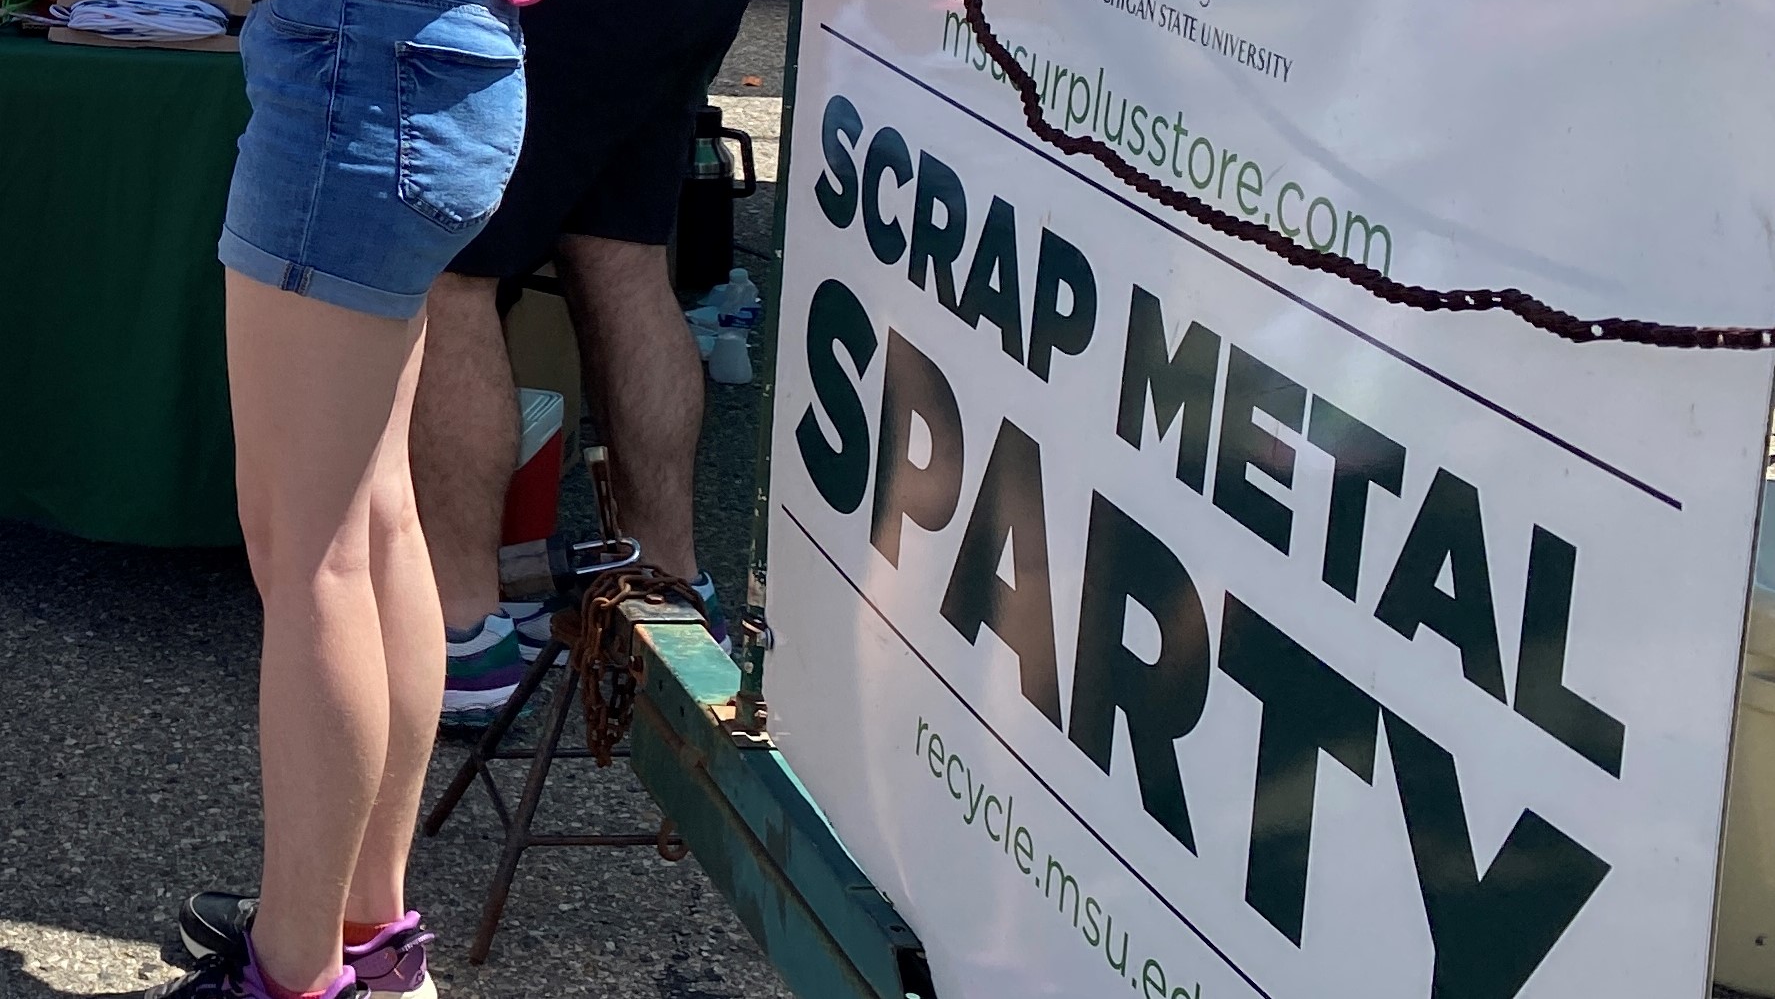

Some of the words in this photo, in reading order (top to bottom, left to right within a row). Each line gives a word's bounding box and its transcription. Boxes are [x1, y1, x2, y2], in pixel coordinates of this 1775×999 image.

[1158, 4, 1198, 42] STATE
[1200, 22, 1294, 83] UNIVERSITY
[796, 279, 1612, 999] SPARTY
[815, 95, 1098, 383] SCRAP
[1116, 284, 1626, 780] METAL
[916, 715, 1201, 999] recycle.msu.e
